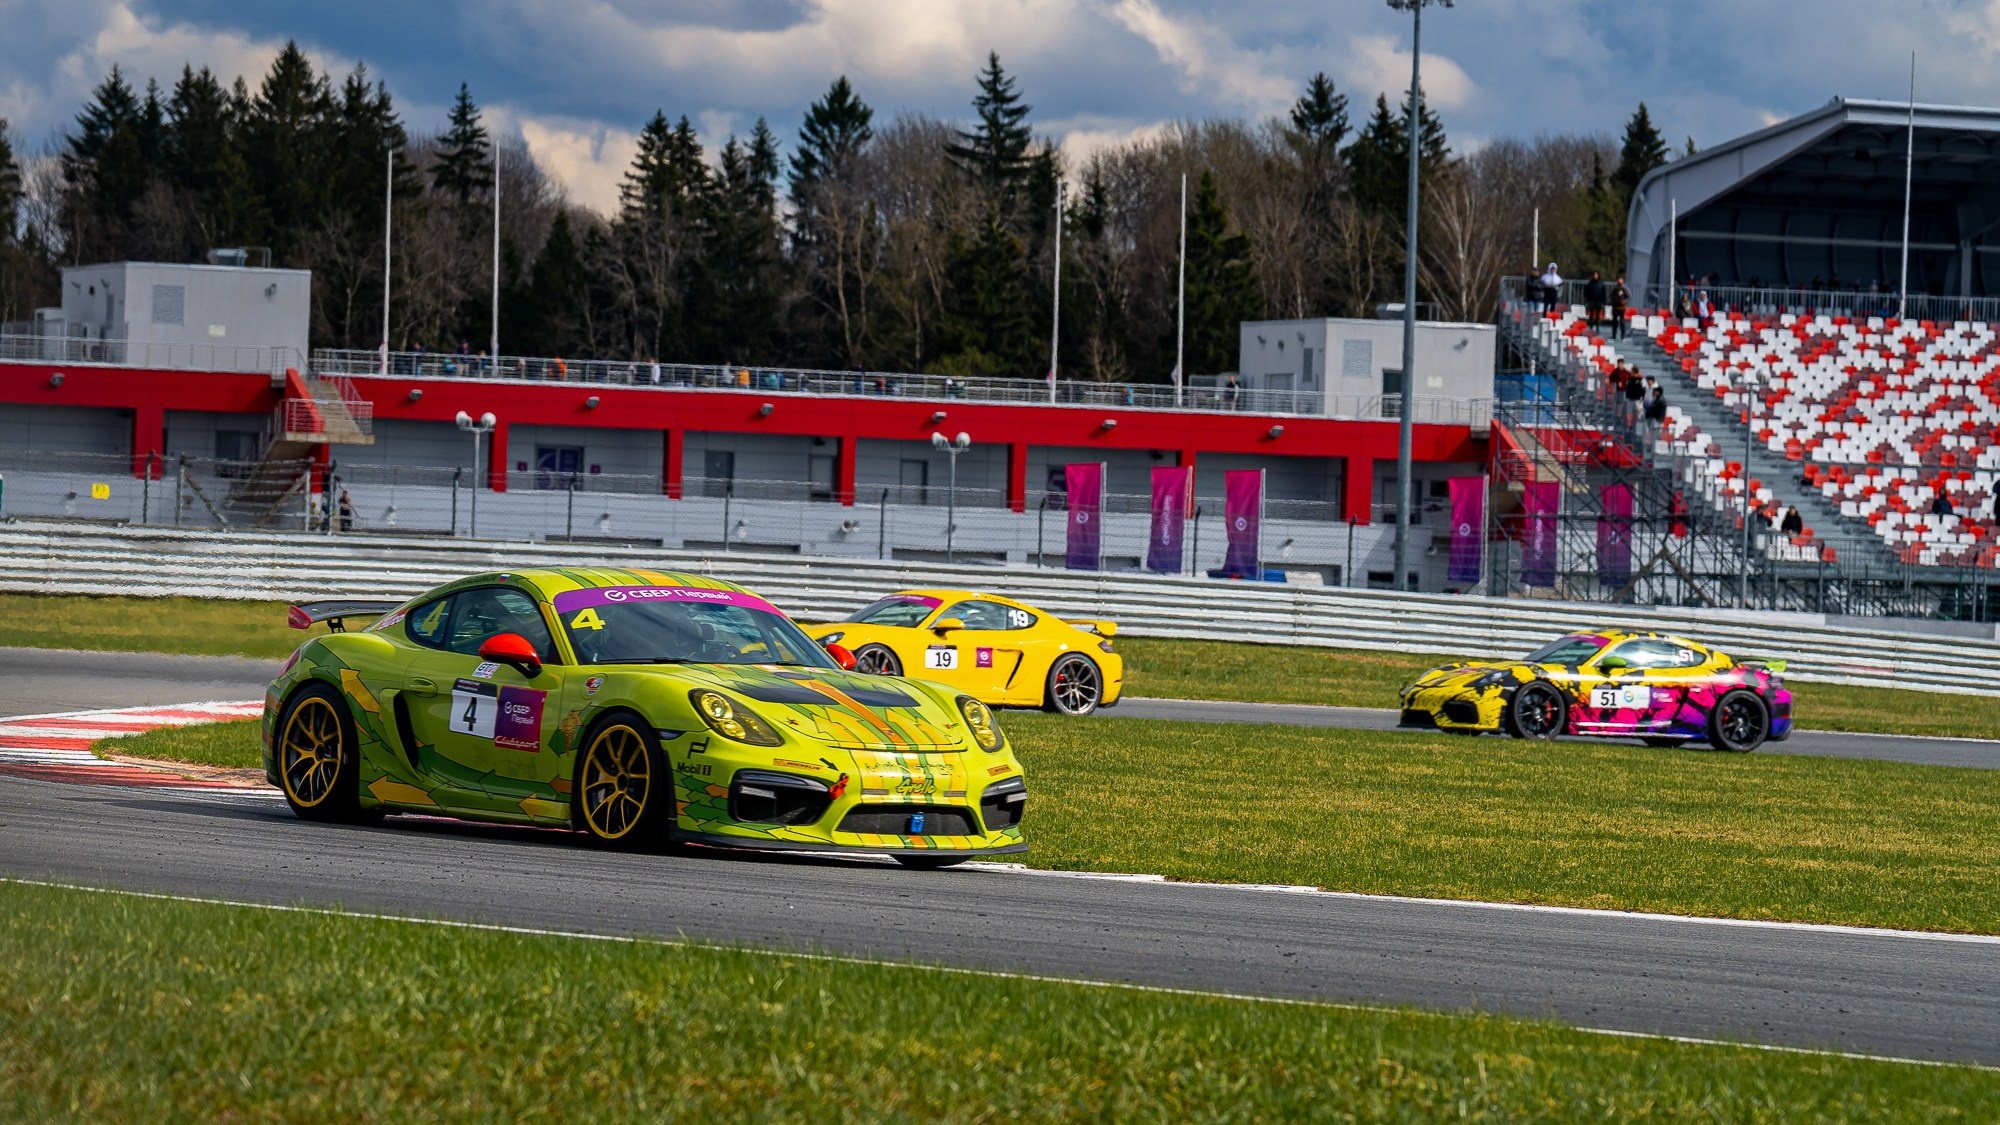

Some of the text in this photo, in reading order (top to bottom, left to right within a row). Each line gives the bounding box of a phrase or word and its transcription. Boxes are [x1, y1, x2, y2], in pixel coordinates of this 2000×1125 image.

[628, 589, 733, 601] СБЕР Первый
[421, 601, 447, 636] 4
[570, 607, 606, 630] 4
[1008, 609, 1029, 627] 19
[936, 652, 952, 667] 19
[1679, 649, 1694, 662] 51
[1600, 691, 1617, 706] 51
[462, 696, 477, 732] 4
[513, 704, 531, 715] СБЕР
[511, 713, 535, 725] Первый
[495, 735, 540, 748] Clubsport
[677, 762, 701, 775] Mobil
[895, 777, 937, 797] Grello
